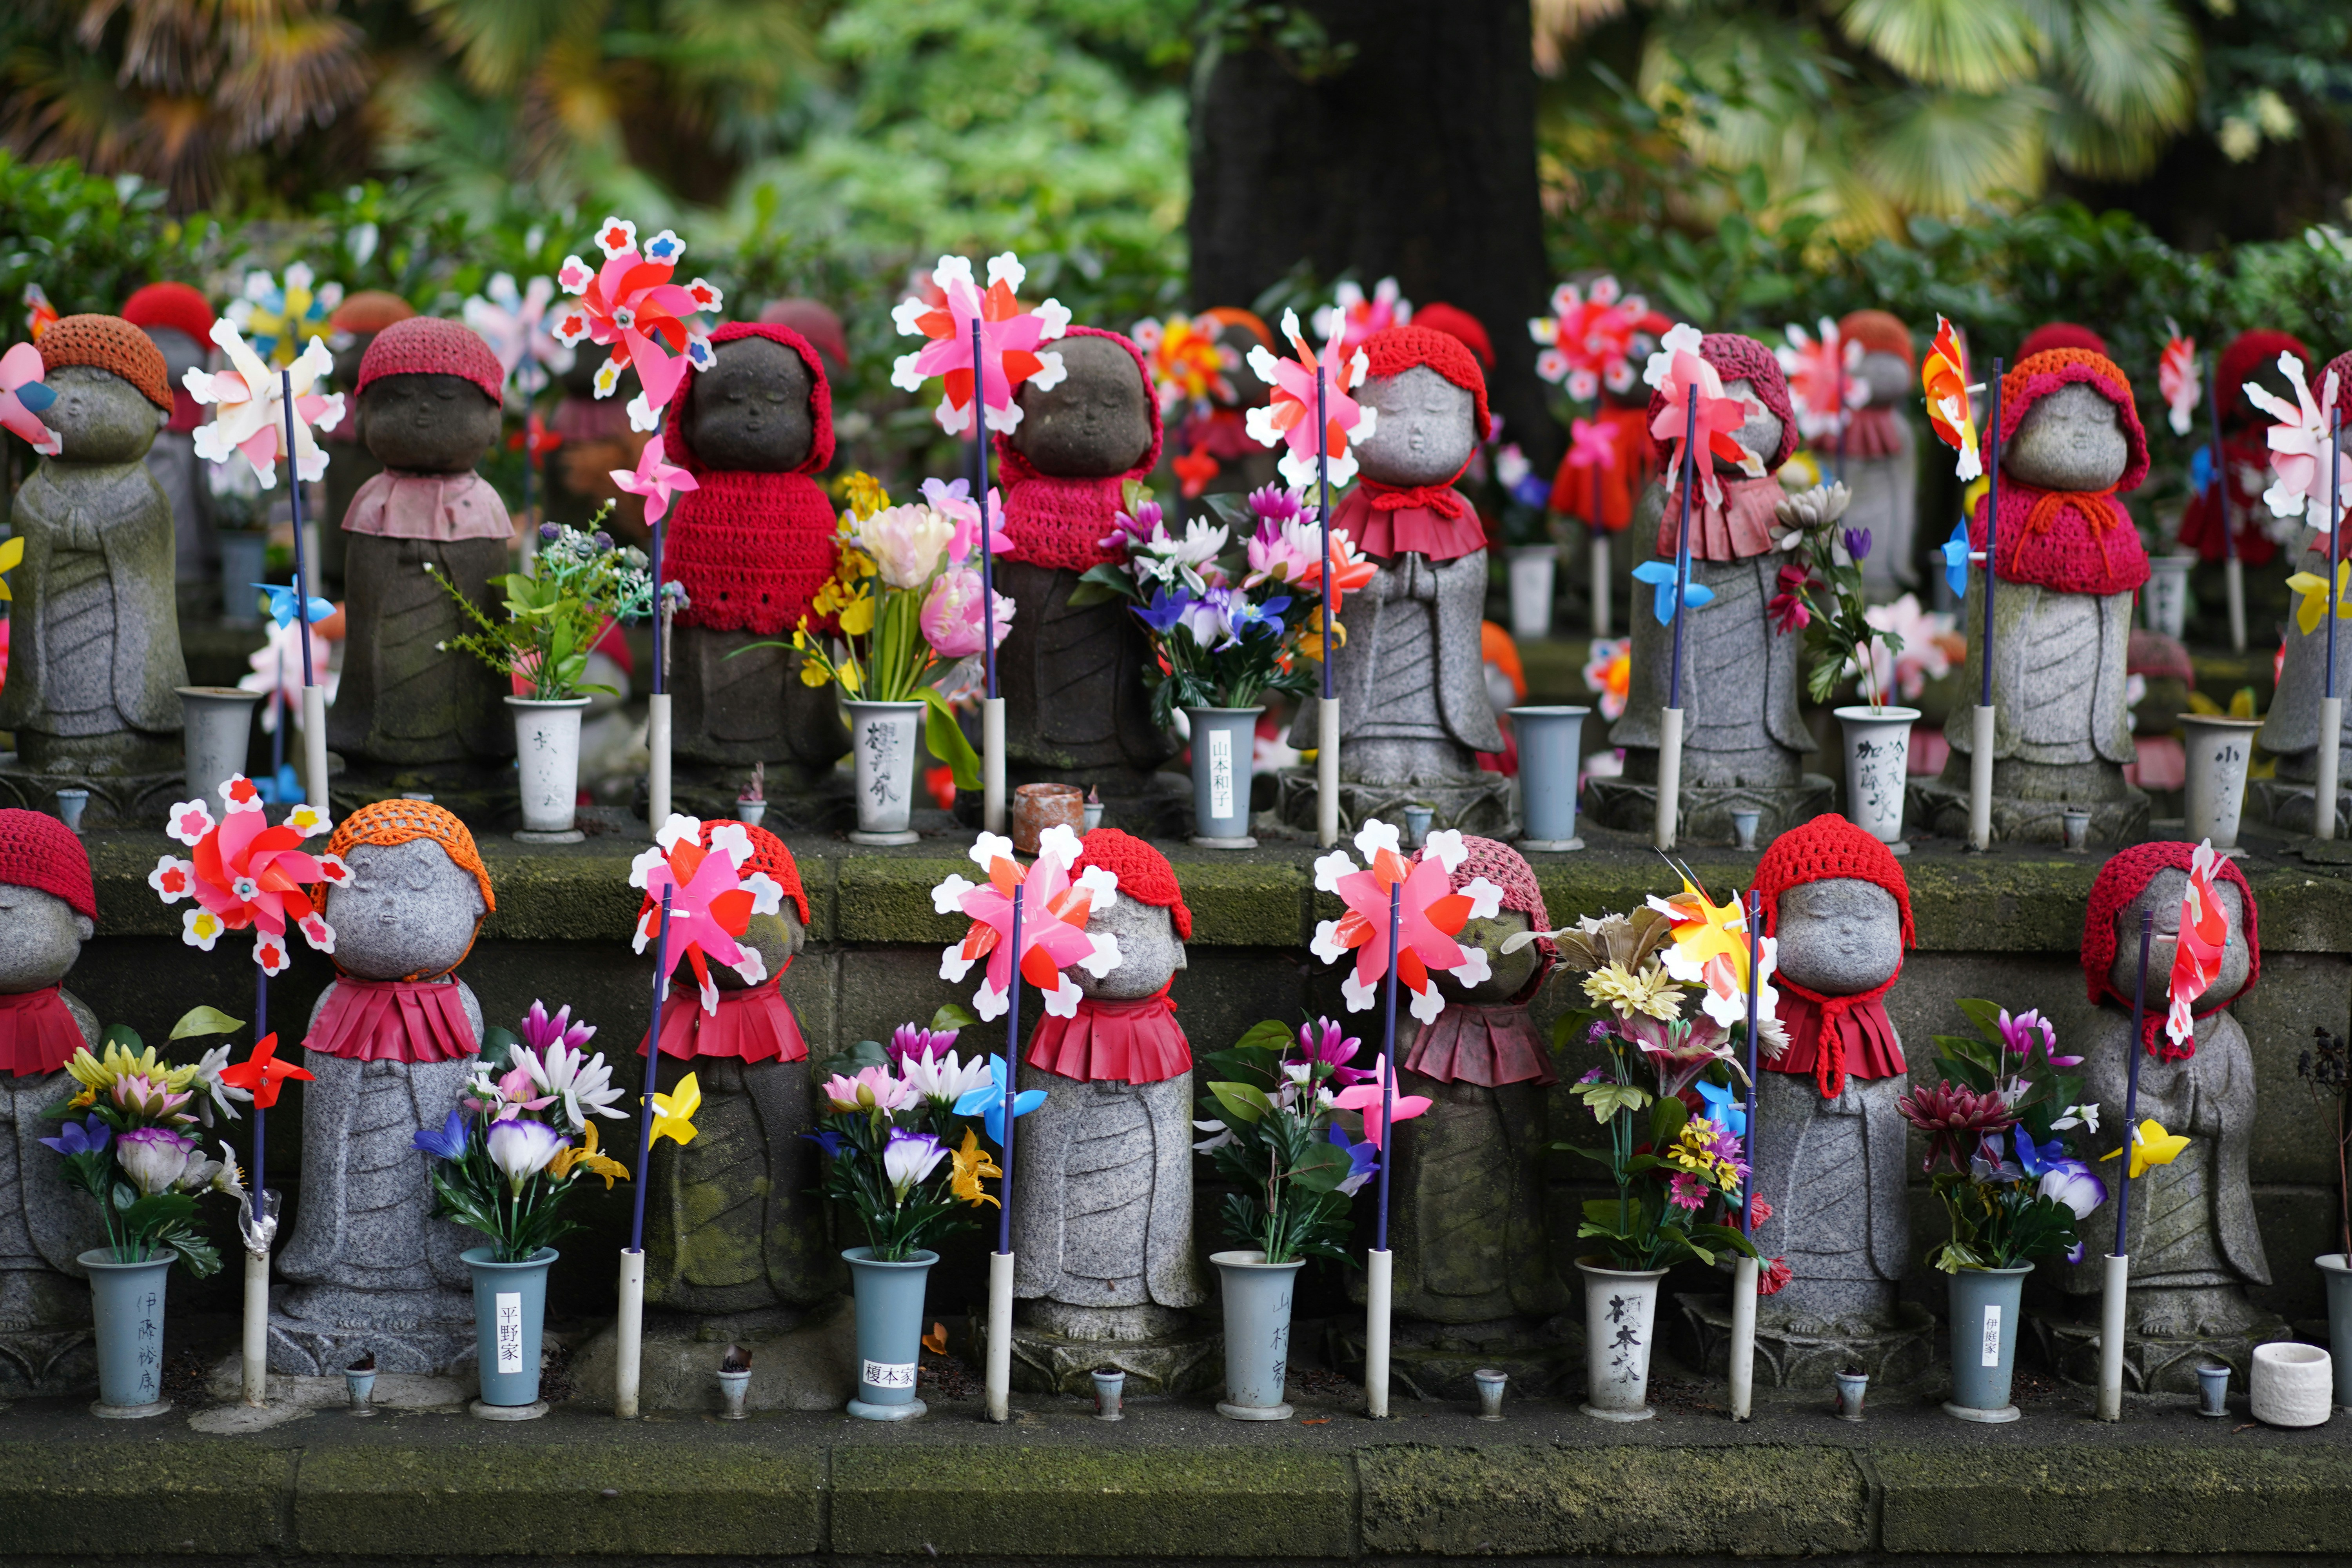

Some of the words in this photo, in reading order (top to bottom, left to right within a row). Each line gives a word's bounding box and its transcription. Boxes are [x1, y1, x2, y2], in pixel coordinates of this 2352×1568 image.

[1213, 742, 1230, 807] 山本和子
[137, 1292, 157, 1393] 伊藤裕康
[501, 1307, 518, 1360] 平野家
[1985, 1318, 1998, 1354] 伊庭家
[865, 1363, 914, 1385] 榎本家
